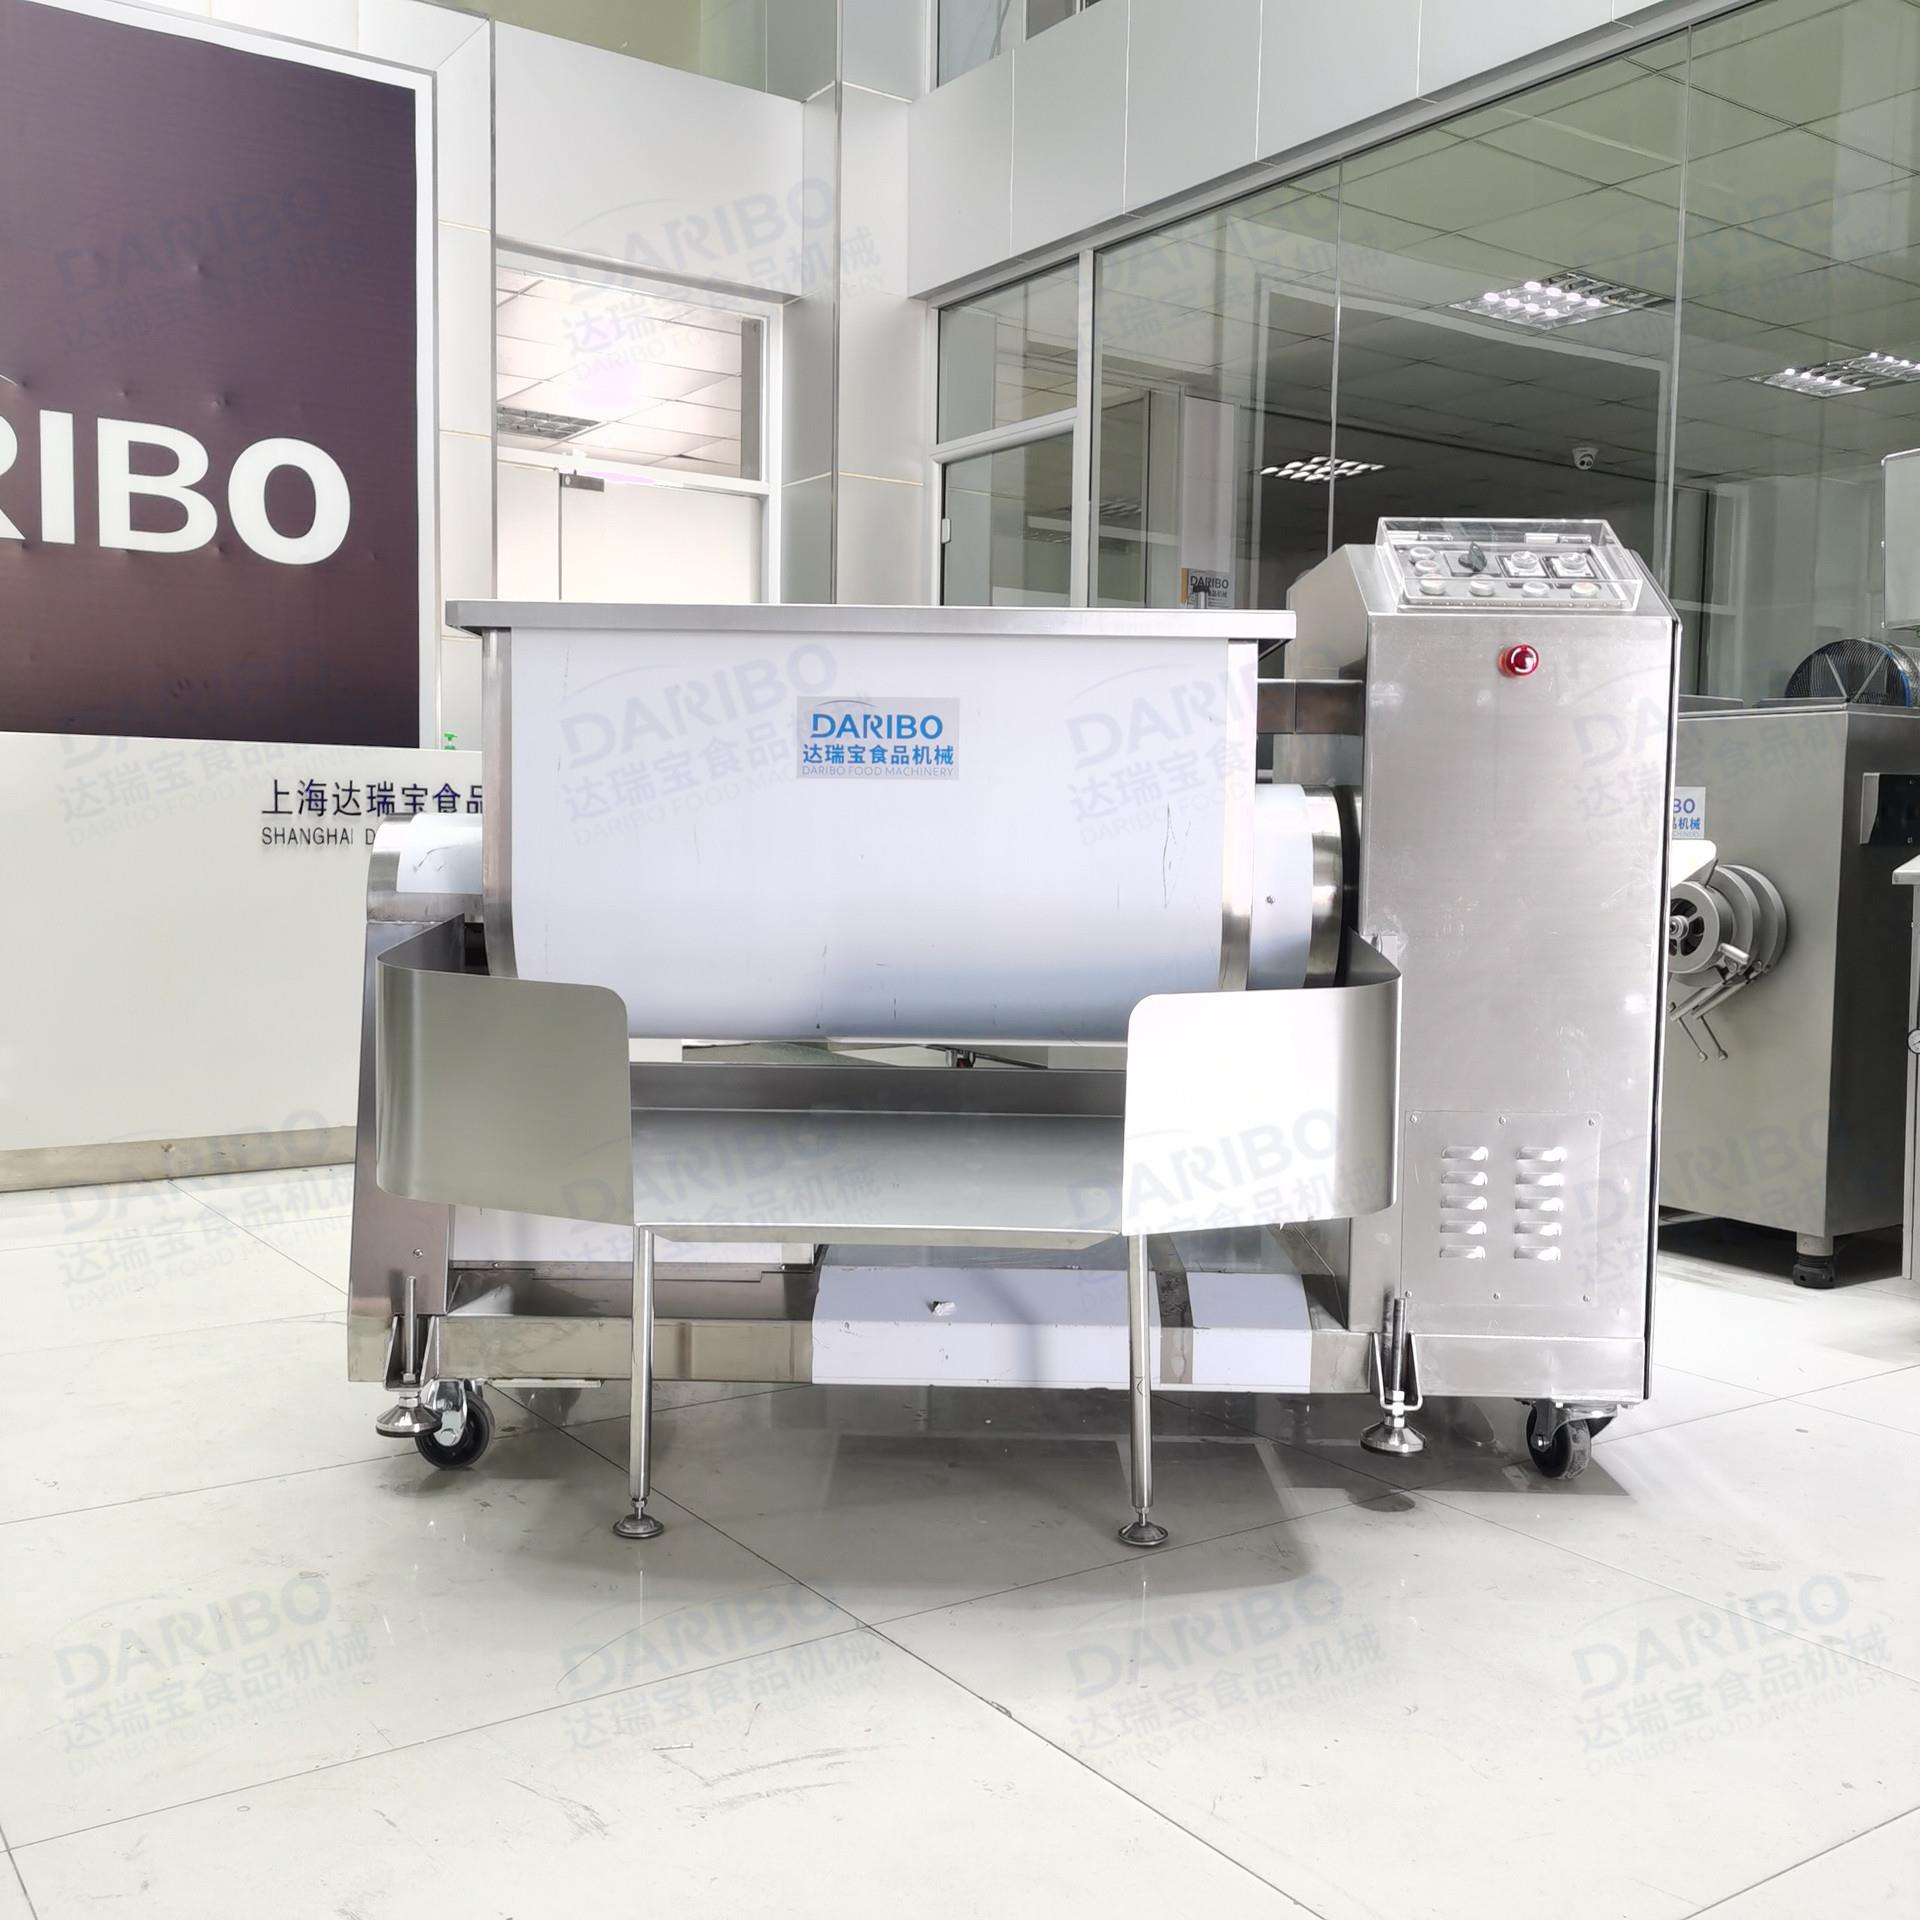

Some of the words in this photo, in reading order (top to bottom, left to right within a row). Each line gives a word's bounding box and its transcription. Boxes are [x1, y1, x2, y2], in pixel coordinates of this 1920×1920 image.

[0, 408, 351, 565] IBO
[810, 713, 943, 740] DARIBO
[803, 743, 954, 765] 达瑞宝食品机械
[802, 766, 845, 776] DARIBO
[849, 767, 882, 776] FOOD
[885, 767, 954, 777] MACHINERY
[262, 826, 353, 846] SHANGHAI
